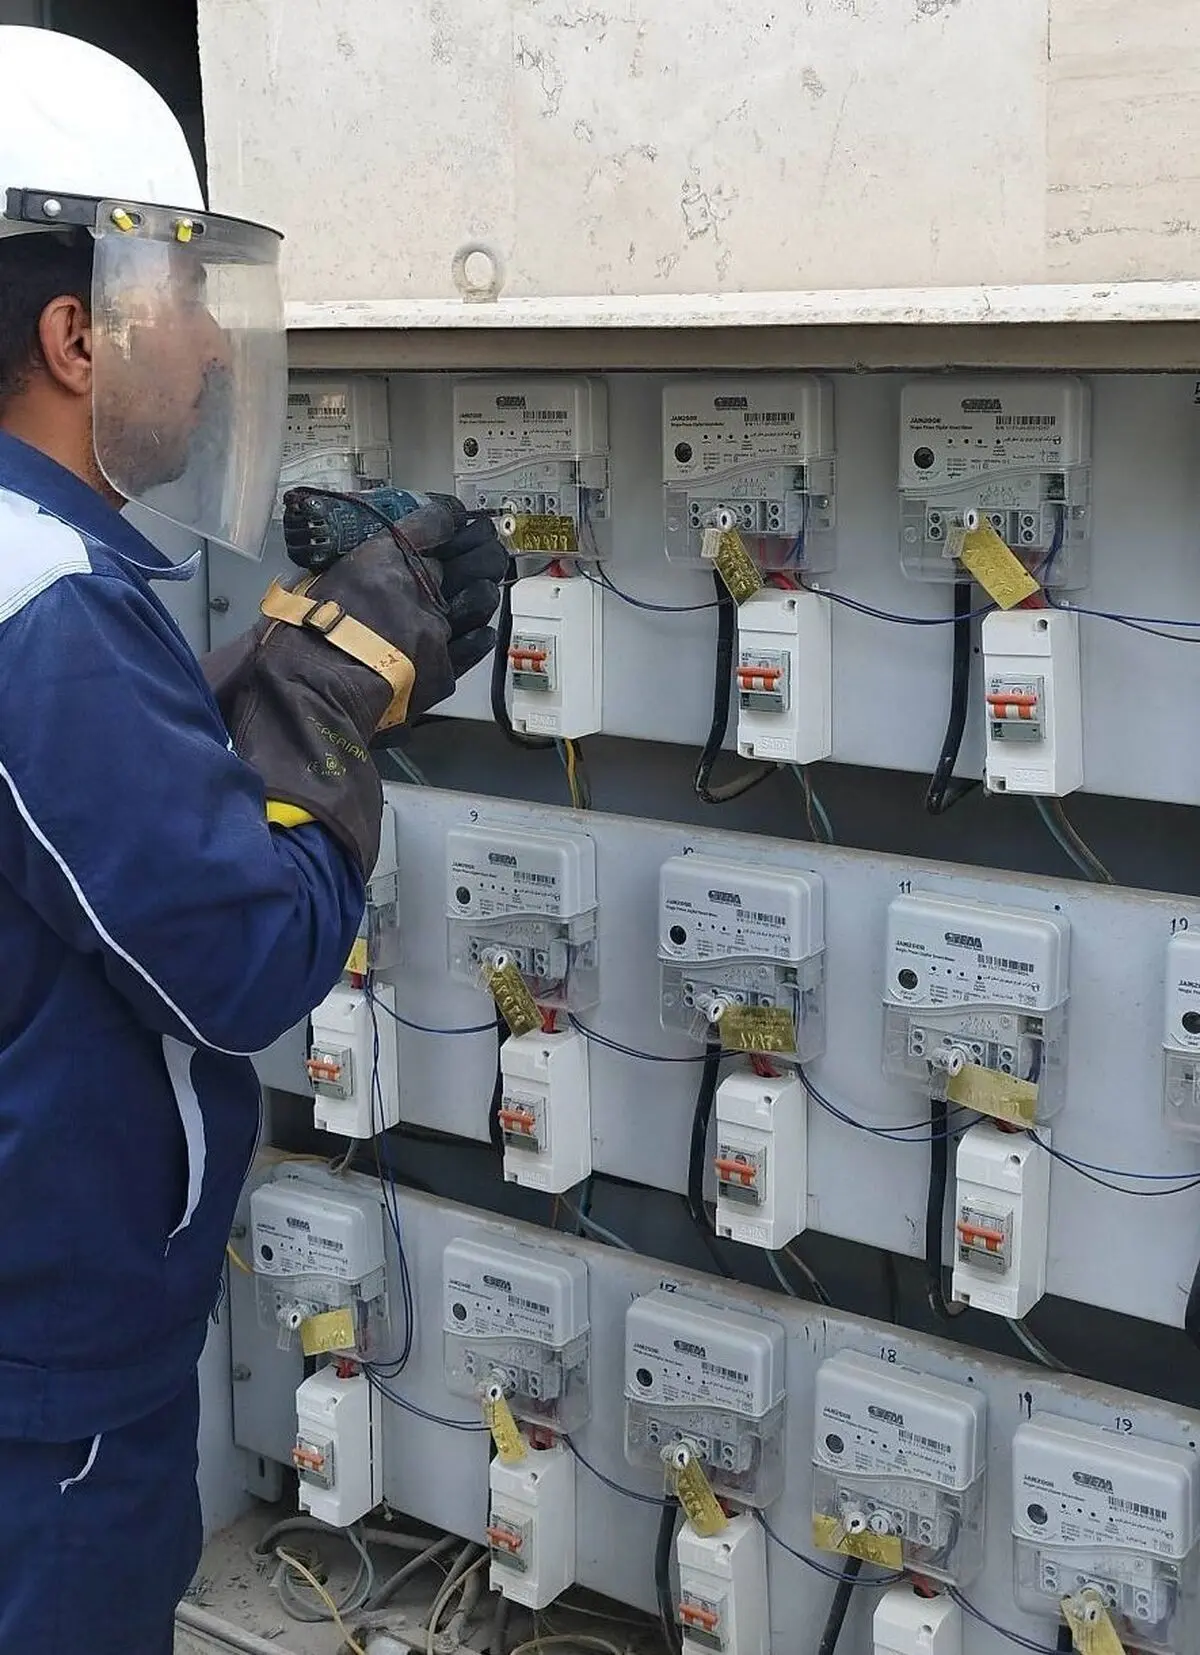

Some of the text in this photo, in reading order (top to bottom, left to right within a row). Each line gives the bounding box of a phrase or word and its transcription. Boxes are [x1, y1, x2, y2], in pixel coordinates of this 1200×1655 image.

[898, 881, 911, 894] 11
[879, 1346, 897, 1363] 18
[1114, 1416, 1133, 1432] 19
